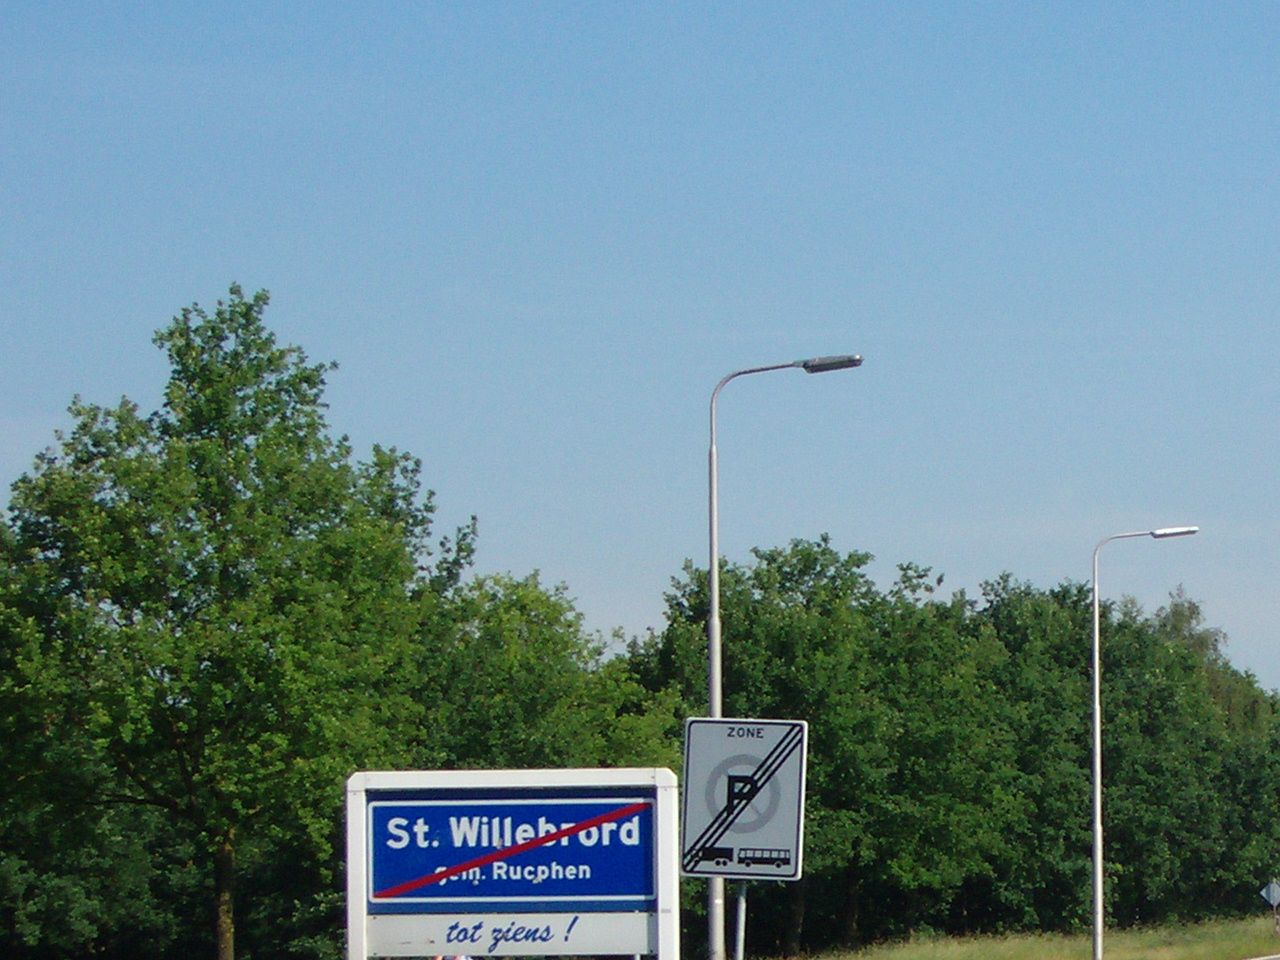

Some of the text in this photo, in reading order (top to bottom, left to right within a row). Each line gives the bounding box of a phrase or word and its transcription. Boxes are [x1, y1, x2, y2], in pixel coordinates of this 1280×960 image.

[727, 727, 764, 739] ZONE
[386, 814, 640, 849] St. Willebrord
[492, 861, 591, 881] Rucphen
[446, 915, 579, 953] tot ziens !
